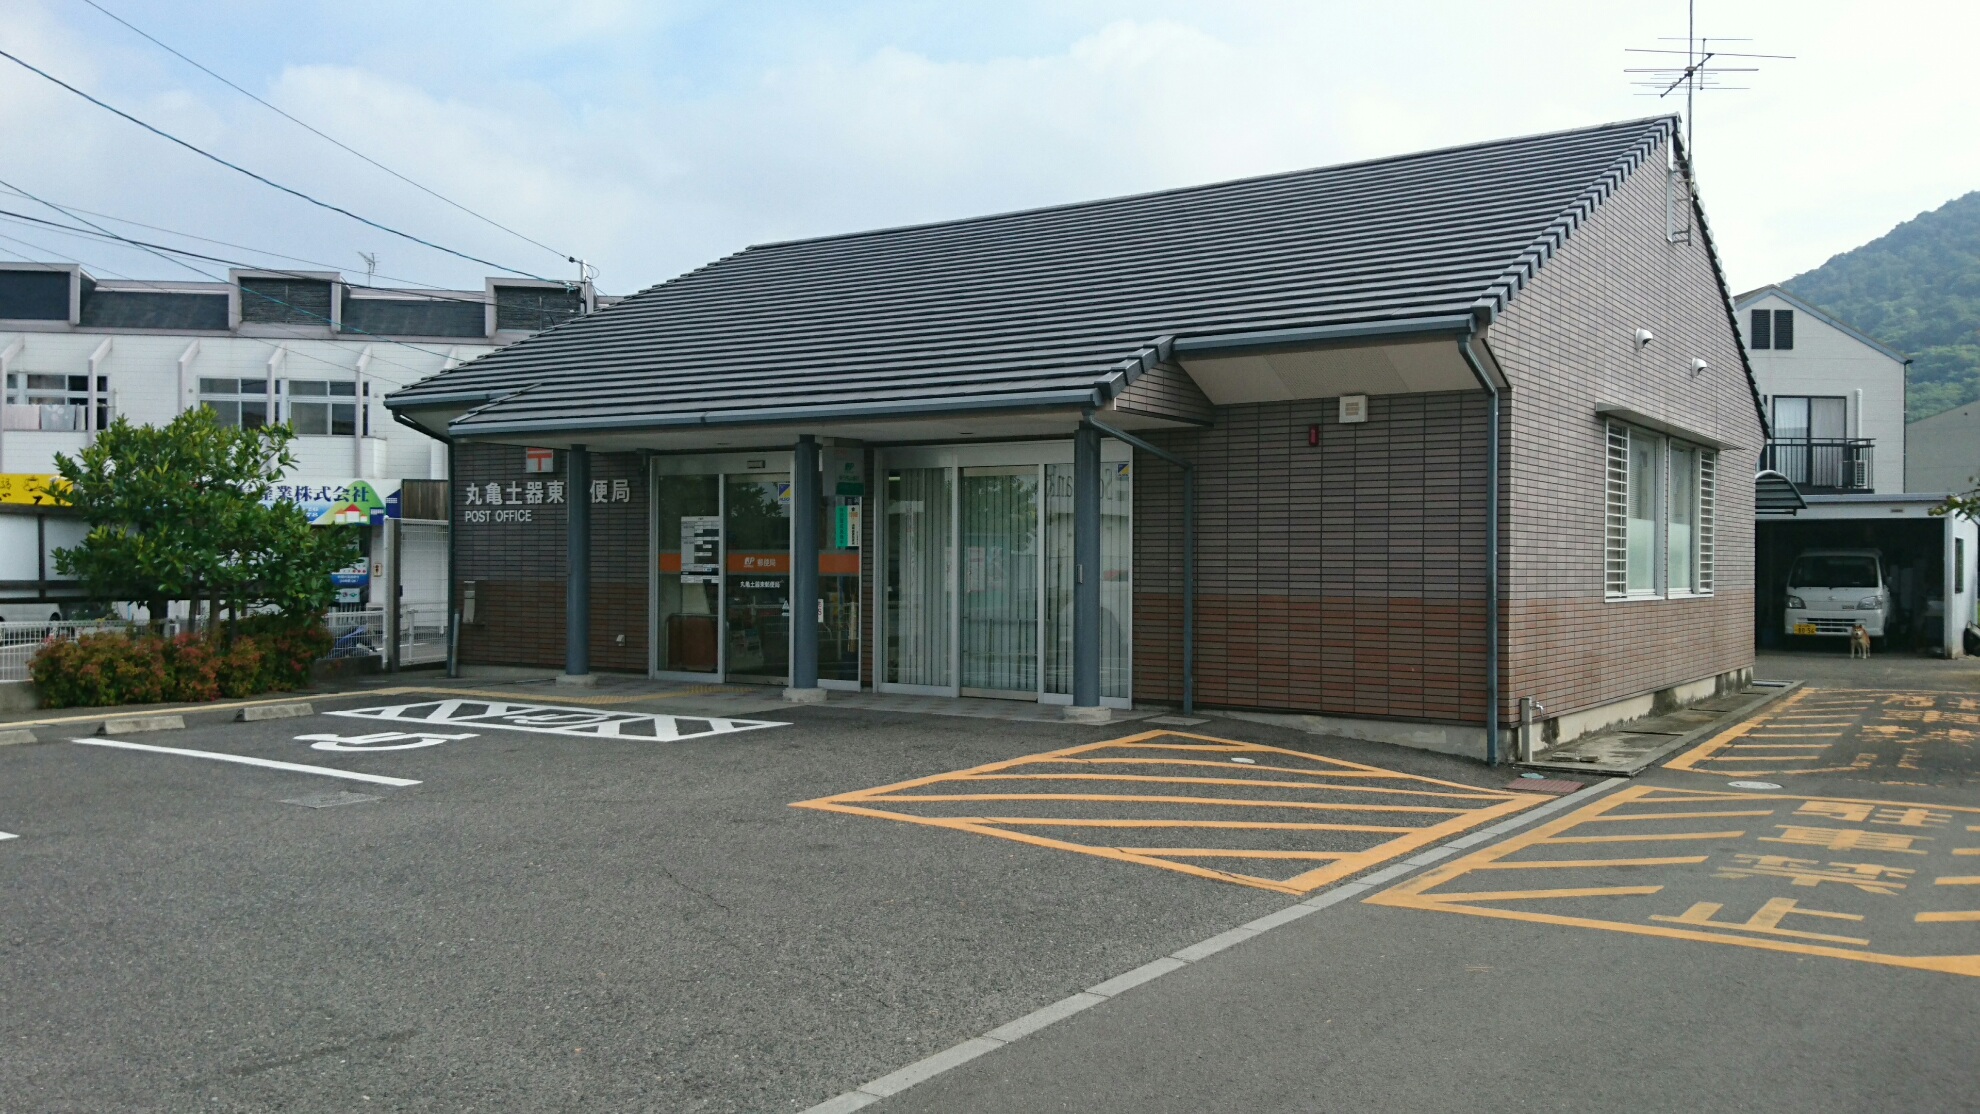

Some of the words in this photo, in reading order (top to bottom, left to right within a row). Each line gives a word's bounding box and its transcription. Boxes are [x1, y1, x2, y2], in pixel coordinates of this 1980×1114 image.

[465, 479, 630, 506] 丸亀土器東便局
[465, 510, 491, 523] POST
[496, 509, 532, 522] OFFICE
